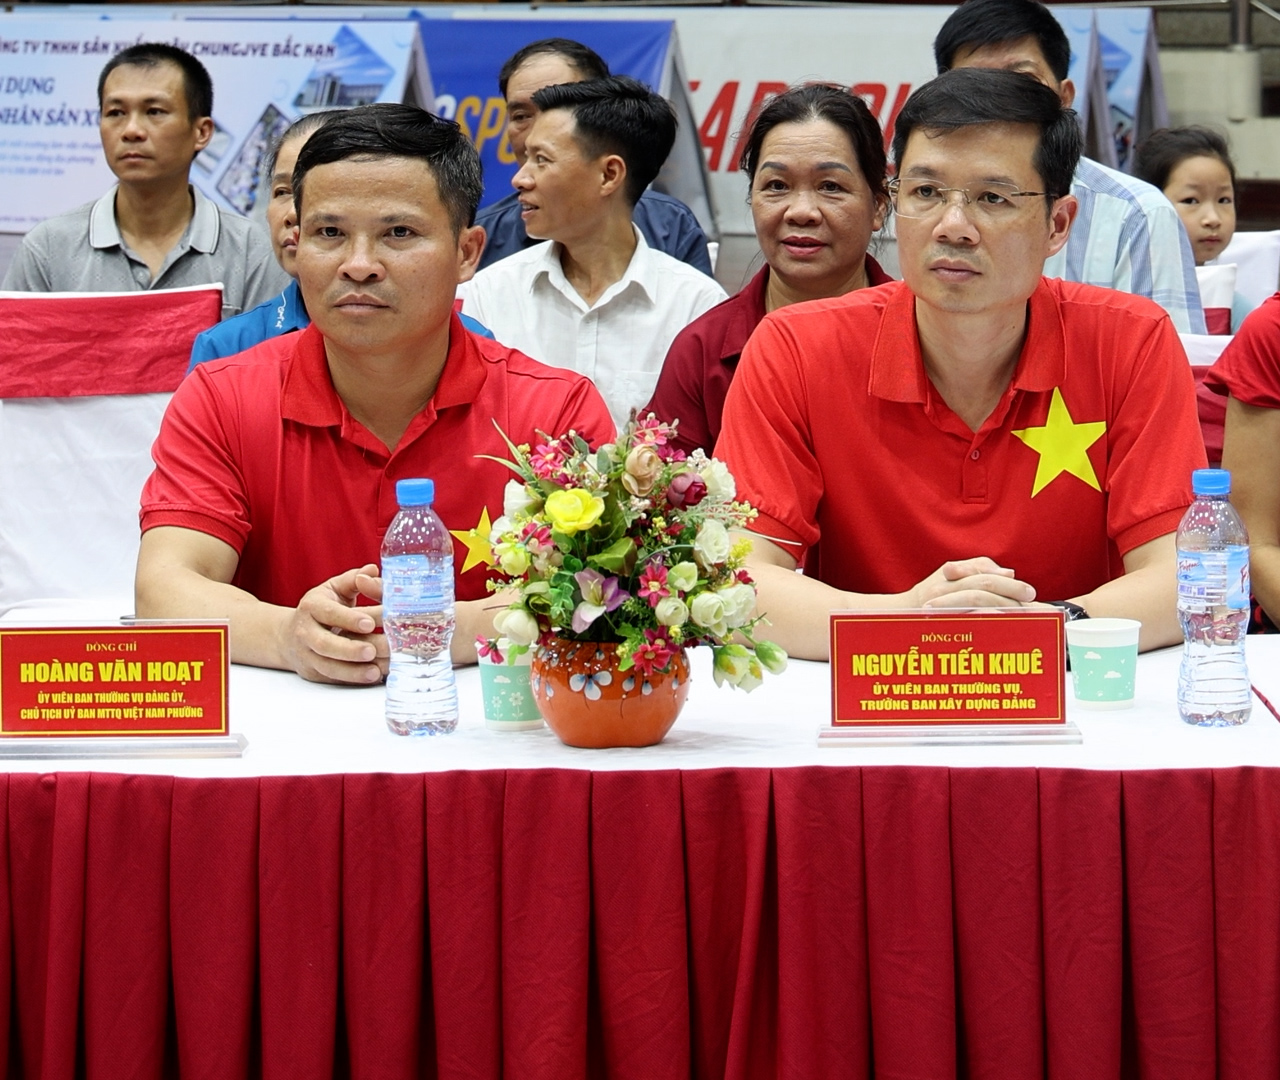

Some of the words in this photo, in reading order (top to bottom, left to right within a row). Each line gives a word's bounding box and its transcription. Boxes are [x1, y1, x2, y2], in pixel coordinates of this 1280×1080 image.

[42, 41, 80, 54] TNHH
[6, 77, 56, 97] DỤNG
[44, 103, 81, 125] SẢN
[954, 633, 972, 641] CHÍ
[118, 642, 136, 651] CHÍ
[853, 646, 933, 676] NGUYỄN
[938, 647, 984, 675] TIẾN
[989, 648, 1043, 674] KHUÊ
[21, 659, 93, 682] HOÀNG
[98, 659, 142, 682] VĂN
[147, 661, 204, 685] HOẠT
[873, 682, 889, 695] ỦY
[892, 682, 921, 694] VIÊN
[924, 684, 949, 694] BAN
[951, 682, 1001, 694] THƯỜNG
[1003, 683, 1023, 697] VỤ,
[38, 691, 50, 704] ỦY
[51, 691, 73, 703] VIÊN
[74, 693, 93, 703] BAN
[94, 691, 130, 703] THƯỜNG
[132, 693, 144, 705] VỤ
[145, 690, 170, 703] ĐẢNG
[860, 698, 909, 710] TRƯỞNG
[912, 700, 937, 710] BAN
[939, 698, 963, 710] XÂY
[966, 698, 1000, 711] DỰNG
[1002, 697, 1036, 709] ĐẢNG
[21, 707, 40, 719] CHỦ
[41, 709, 62, 721] TỊCH
[78, 709, 96, 719] BAN
[97, 709, 122, 719] MTTQ
[123, 708, 144, 721] VIỆT
[145, 708, 166, 718] NAM
[167, 706, 203, 718] PHƯỜNG
